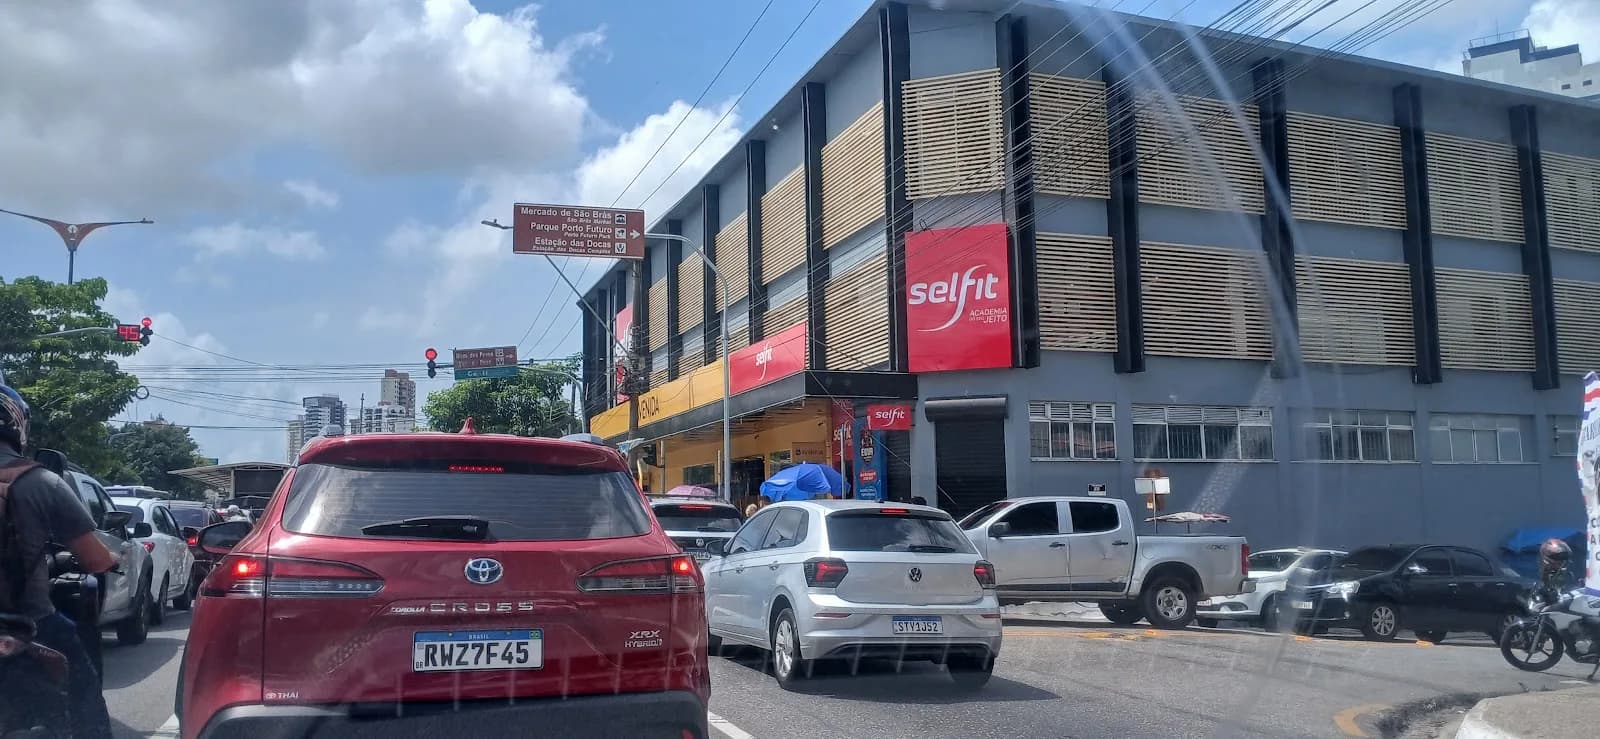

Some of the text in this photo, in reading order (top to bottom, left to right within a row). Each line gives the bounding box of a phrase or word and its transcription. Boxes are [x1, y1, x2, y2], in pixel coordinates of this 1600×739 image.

[521, 207, 612, 219] Mercado de São Brás
[530, 222, 612, 234] Parque Porto Futuro
[535, 236, 612, 248] Estação das Docas
[909, 264, 999, 332] selfit
[969, 307, 1007, 317] ACADEMIA
[984, 314, 1007, 324] JEITO
[119, 325, 139, 341] 45
[755, 341, 773, 381] selfit
[637, 396, 660, 420] VENIDA
[875, 407, 905, 427] selfit
[391, 601, 535, 614] COROLLA CROSS
[898, 621, 939, 632] STY1J52
[629, 630, 661, 639] XRX
[424, 641, 529, 667] RWZ7F45
[415, 661, 424, 669] BR
[277, 691, 299, 699] THAI
